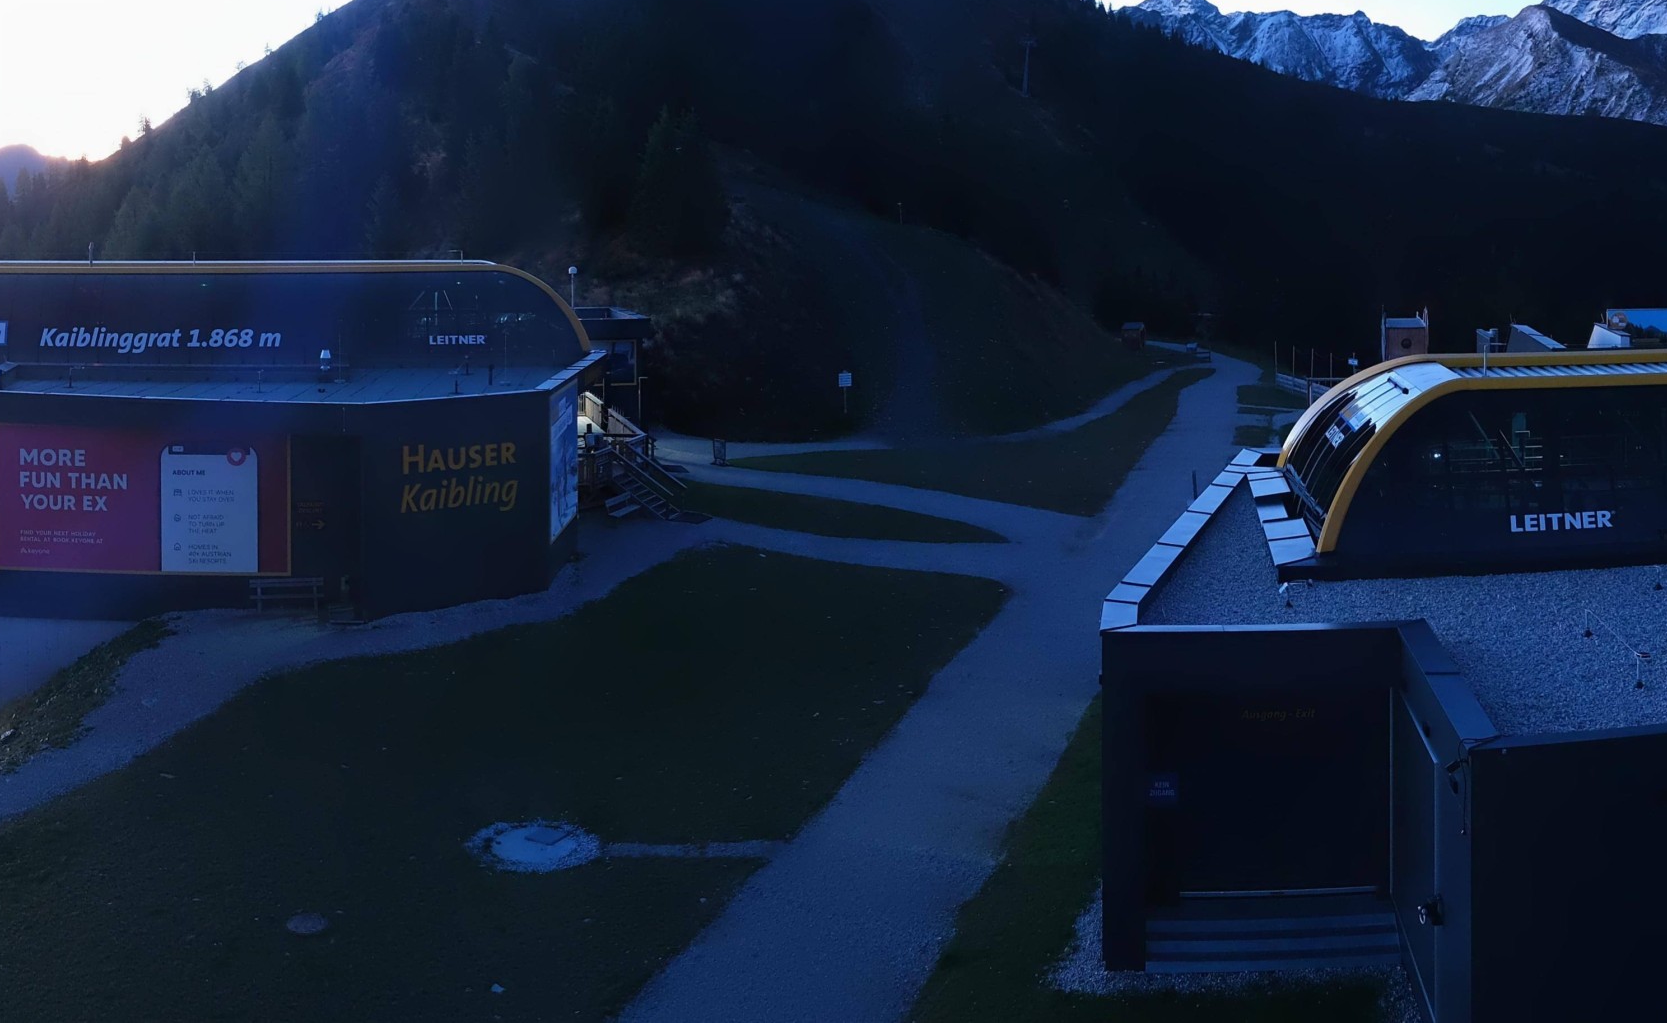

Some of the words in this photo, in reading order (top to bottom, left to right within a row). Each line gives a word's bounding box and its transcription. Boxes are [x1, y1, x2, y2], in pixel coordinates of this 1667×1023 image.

[40, 327, 182, 353] Kaiblinggrat
[187, 328, 254, 348] 1.868
[259, 332, 281, 347] m
[429, 334, 486, 345] LEITNER
[19, 448, 86, 467] MORE
[402, 442, 517, 475] HAUSER
[19, 471, 61, 488] FUN
[68, 473, 128, 490] THAN
[20, 494, 76, 510] YOUR
[83, 495, 108, 511] EX
[400, 476, 519, 514] Kaibling
[1510, 511, 1613, 533] LEITNER
[1241, 709, 1287, 721] Ausgang
[1295, 707, 1316, 718] Exit
